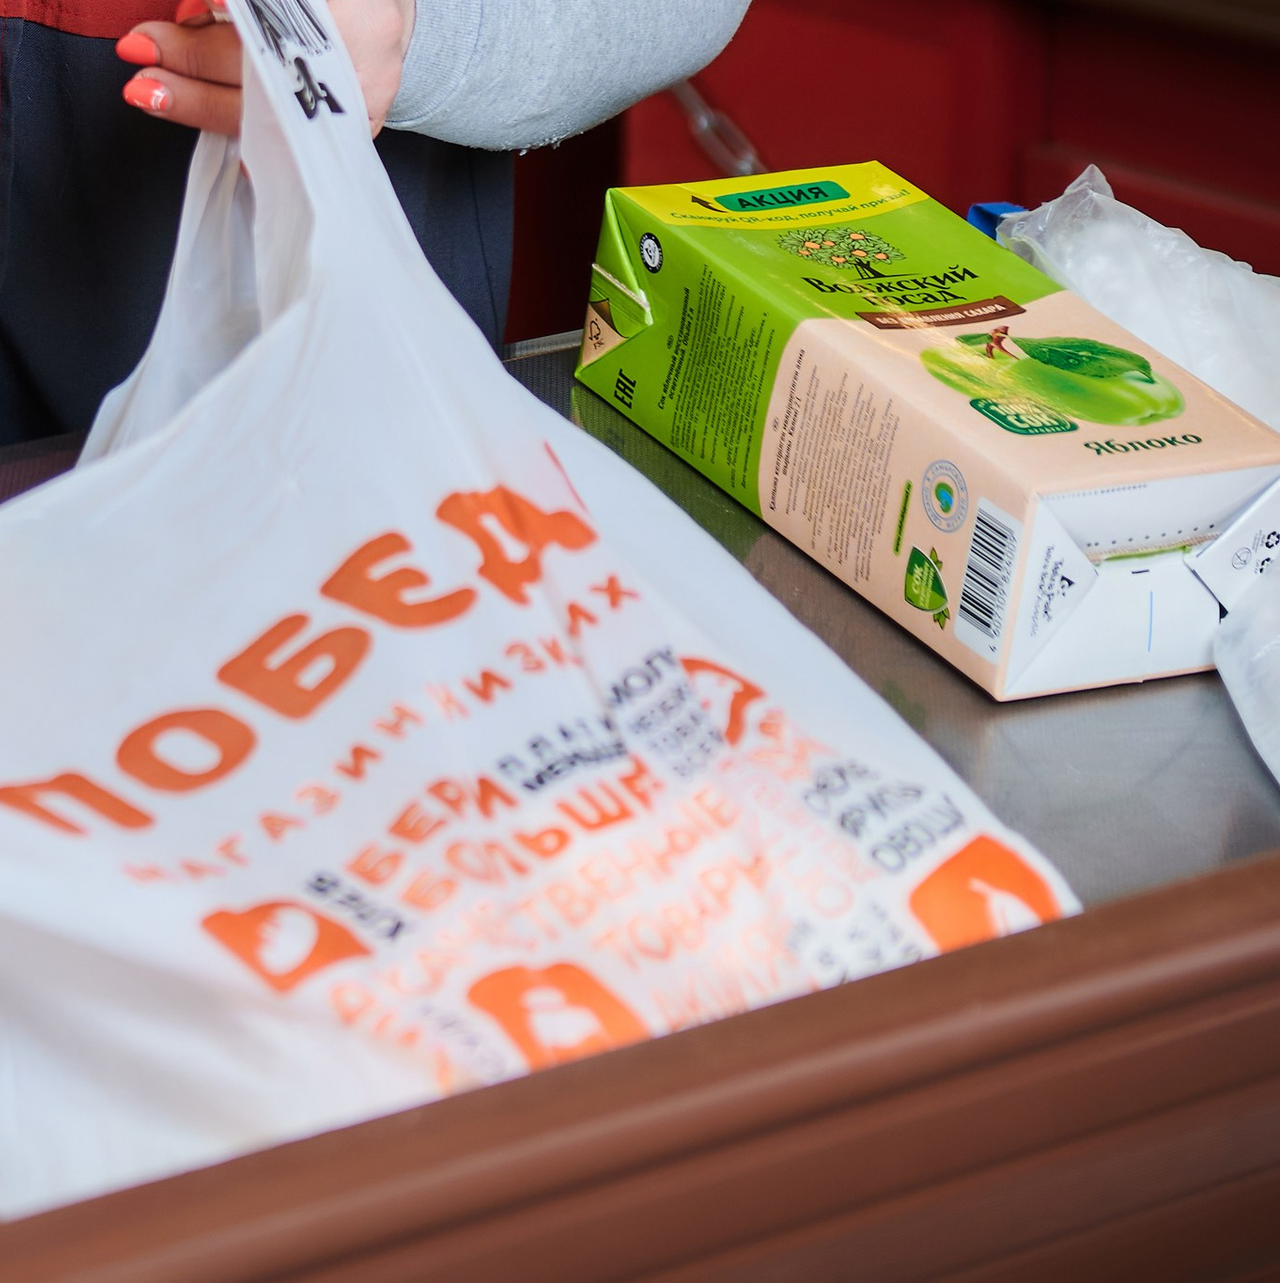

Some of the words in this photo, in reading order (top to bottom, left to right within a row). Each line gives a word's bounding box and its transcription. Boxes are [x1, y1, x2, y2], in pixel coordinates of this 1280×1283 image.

[737, 186, 830, 210] АКЦИЯ
[670, 211, 737, 224] Сканируй
[800, 204, 859, 220] получай
[963, 303, 1008, 318] САХАРА
[1084, 433, 1203, 456] Яблоко
[344, 771, 520, 885] БЕРИ
